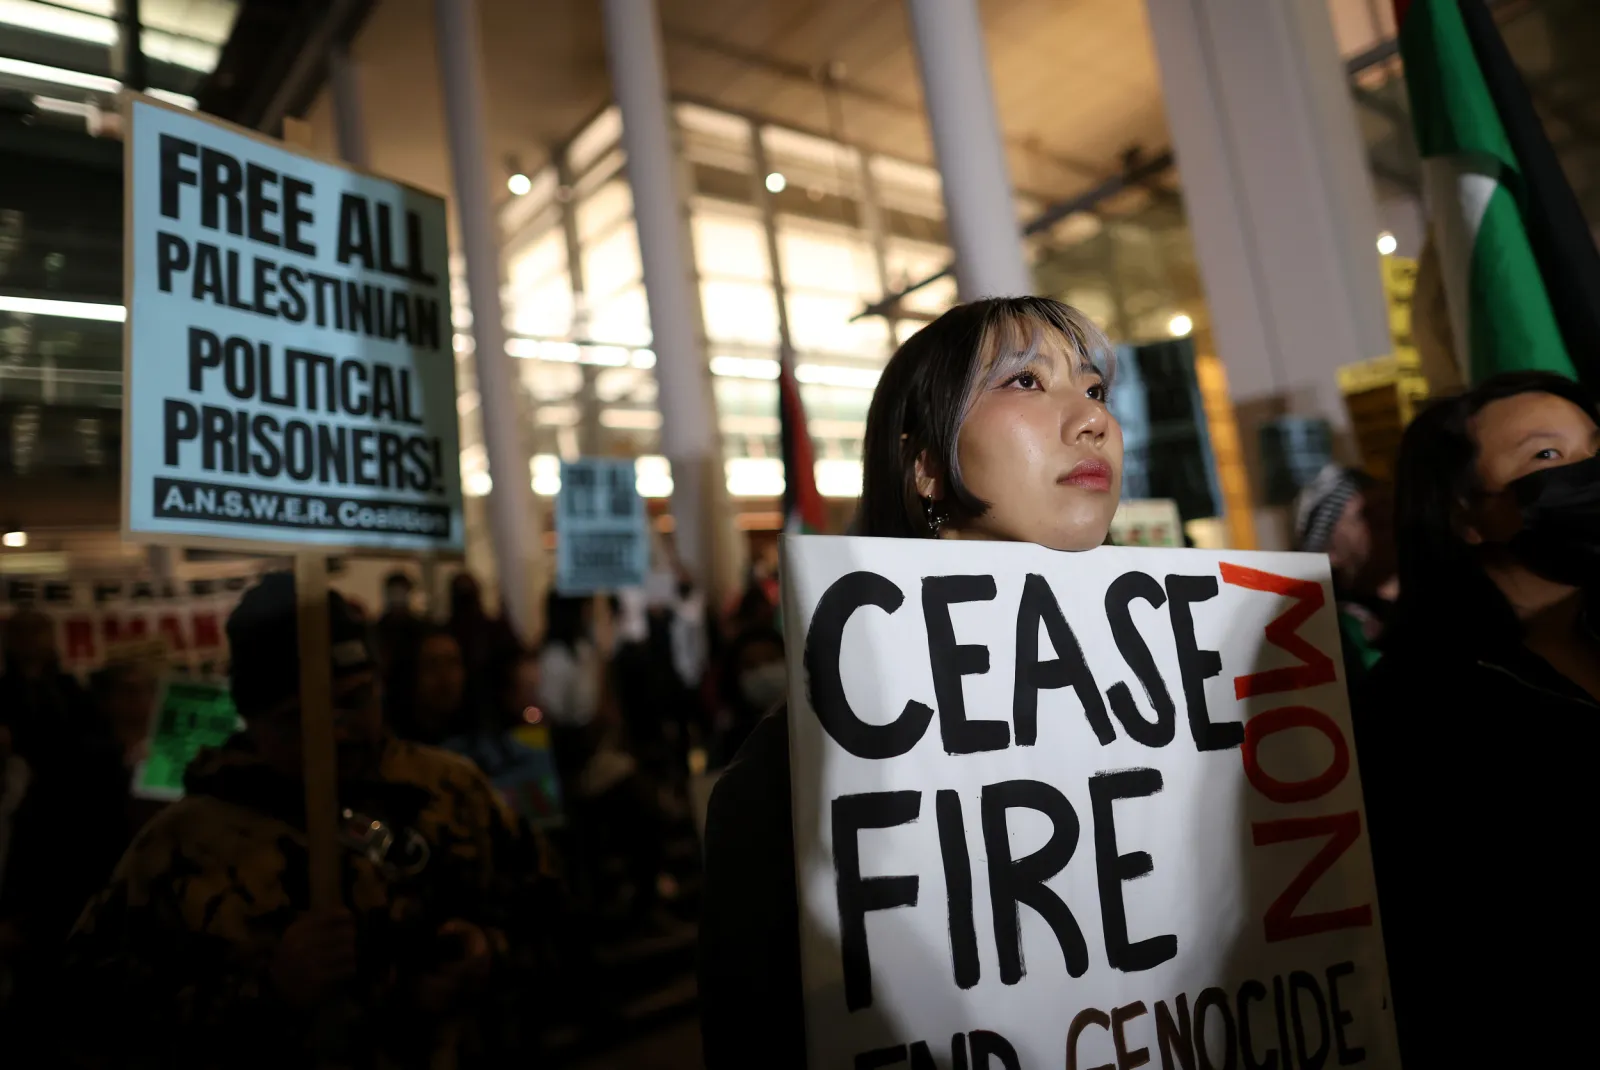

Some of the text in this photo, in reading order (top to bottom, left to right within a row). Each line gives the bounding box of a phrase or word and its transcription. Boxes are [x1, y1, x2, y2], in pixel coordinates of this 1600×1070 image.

[159, 132, 436, 287] FREE ALL
[157, 231, 440, 352] PALESTINIAN
[187, 326, 423, 425] POLITICAL
[162, 485, 334, 525] A.N.S.W.E.R.
[163, 398, 445, 495] PRISONERS!
[803, 570, 1245, 760] CEASE
[1218, 561, 1373, 943] NOW
[831, 767, 1178, 1013] FIRE
[1065, 961, 1366, 1070] GENOCIDE
